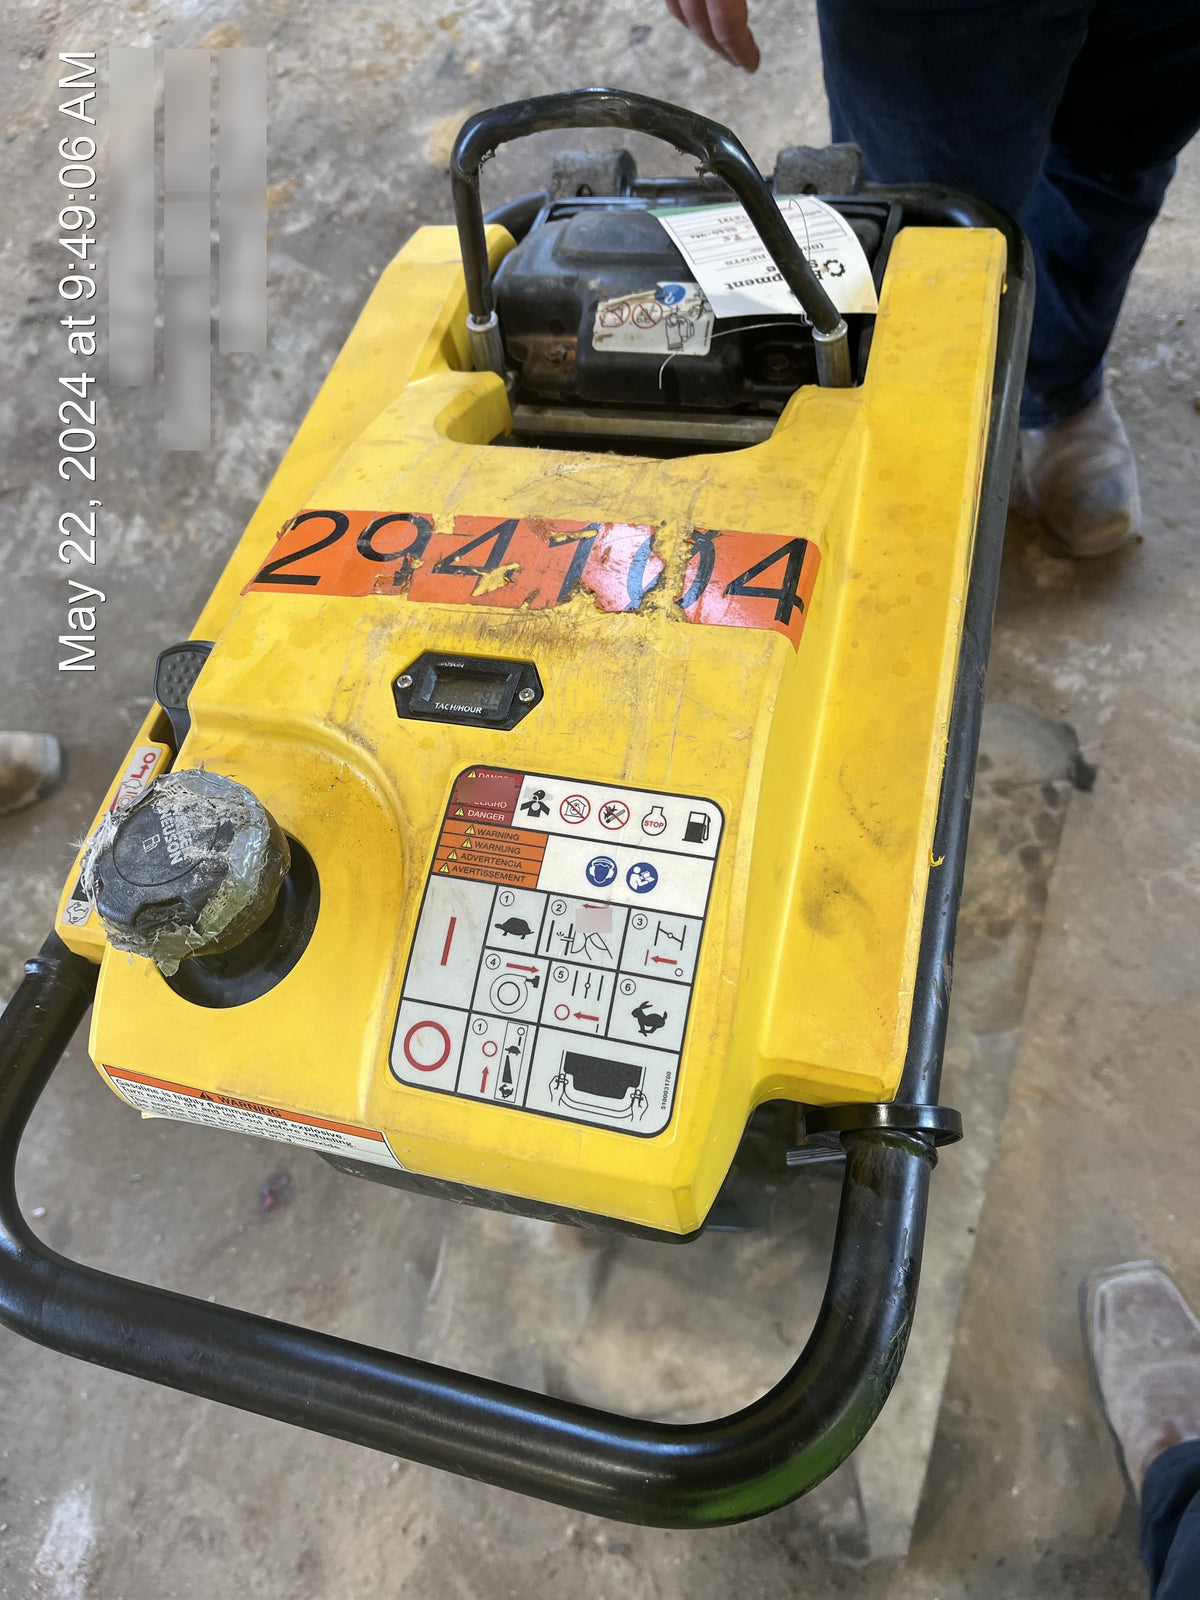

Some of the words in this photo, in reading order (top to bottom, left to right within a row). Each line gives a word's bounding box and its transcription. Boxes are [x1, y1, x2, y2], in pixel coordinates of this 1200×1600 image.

[254, 511, 805, 627] 294104
[467, 809, 506, 821] DANGER
[644, 820, 665, 830] STOP
[477, 828, 520, 841] WARNING
[474, 841, 521, 854] WARNUNG
[460, 853, 523, 868] ADVERTENCIA
[451, 865, 526, 883] AVERTISSEMENT
[660, 1070, 673, 1111] 5100031700
[115, 1078, 159, 1095] Gasoline
[162, 1090, 172, 1099] is
[173, 1092, 205, 1107] highly
[207, 1098, 264, 1120] flammable
[267, 1117, 288, 1127] and
[291, 1122, 347, 1140] explosive.
[130, 1095, 149, 1105] The
[150, 1101, 185, 1114] engine
[218, 1116, 245, 1127] toxic
[217, 1095, 282, 1118] WARNING
[121, 1086, 145, 1097] Turn
[147, 1092, 181, 1107] engine
[183, 1100, 198, 1110] off
[201, 1106, 220, 1116] and
[222, 1111, 236, 1120] let
[240, 1115, 263, 1125] cool
[265, 1121, 301, 1135] before
[303, 1131, 356, 1148] refueling.
